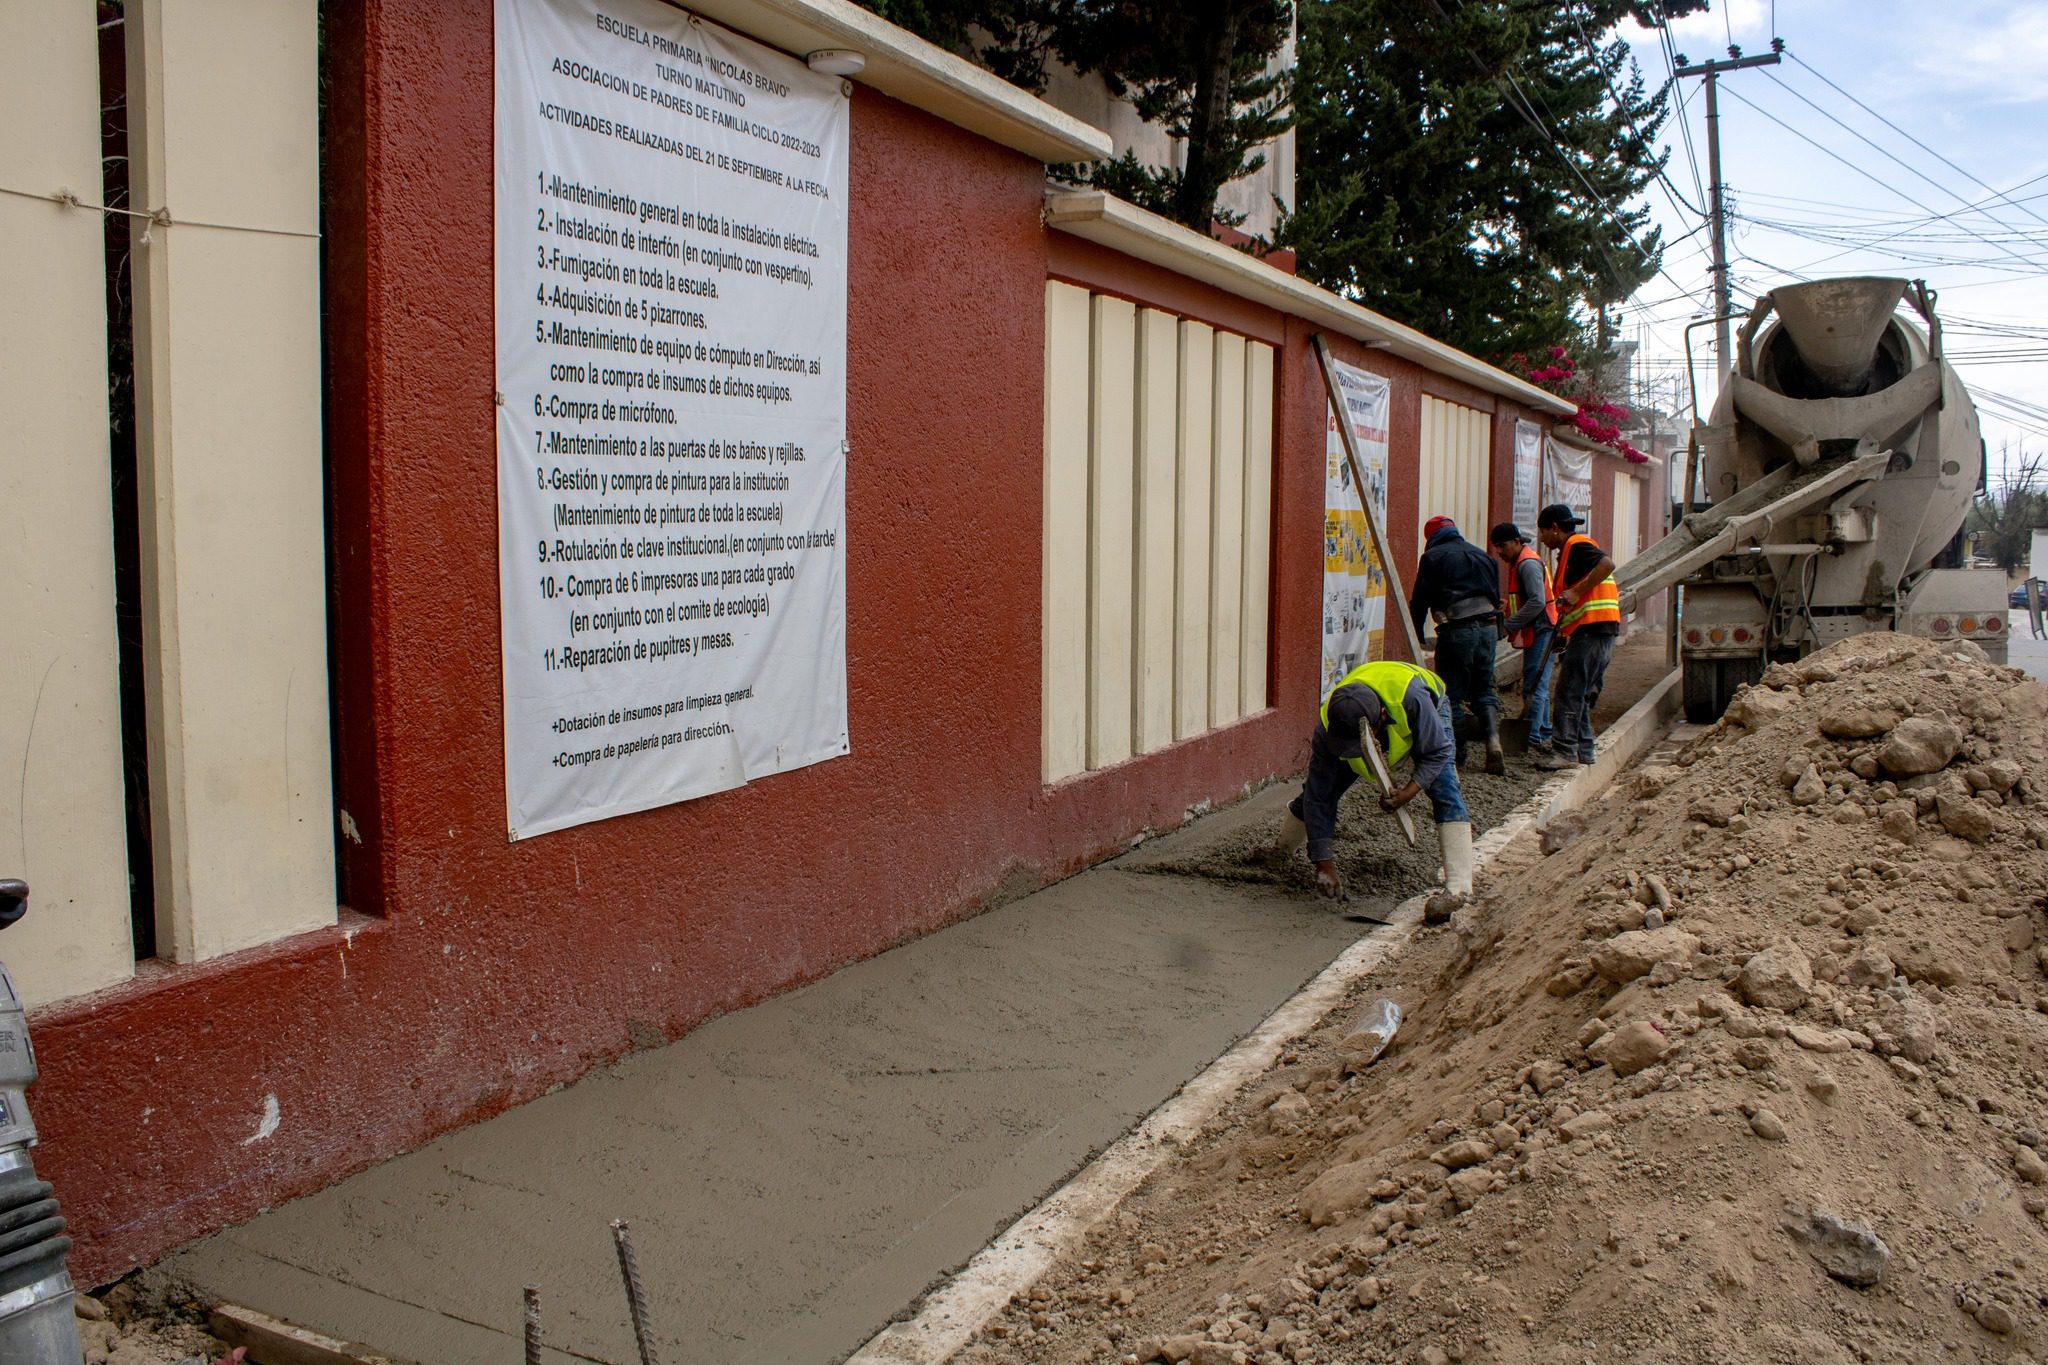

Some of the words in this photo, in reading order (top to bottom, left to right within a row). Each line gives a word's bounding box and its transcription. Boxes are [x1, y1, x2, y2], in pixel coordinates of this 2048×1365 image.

[597, 14, 650, 47] ESCUELA
[653, 35, 703, 67] PRIMARIA
[552, 57, 630, 95] ASOCIACION
[633, 84, 648, 101] DE
[651, 90, 693, 116] PADRES
[695, 104, 710, 122] DE
[712, 109, 750, 134] FAMILIA
[752, 122, 779, 144] CICLO
[781, 131, 821, 158] 2022-2023
[656, 63, 693, 88] TURNO
[695, 74, 746, 108] MATUTINO
[539, 101, 612, 136] ACTIVIDADES
[686, 145, 703, 163] DEL
[706, 150, 716, 167] 21
[718, 153, 730, 170] DE
[732, 158, 783, 187] SEPTIEMBRE
[805, 180, 829, 200] FECHA
[556, 211, 618, 247] Instalación
[621, 227, 635, 250] de
[638, 230, 680, 259] interfón
[682, 240, 698, 266] (en
[701, 248, 743, 272] conjunto
[745, 258, 762, 276] con
[765, 261, 813, 290] vespertino).
[639, 202, 680, 226] general
[682, 211, 695, 228] en
[697, 211, 719, 235] toda
[721, 216, 730, 237] la
[732, 219, 781, 249] instalación
[784, 233, 820, 258] eléctrica.
[622, 266, 636, 285] en
[639, 266, 663, 290] toda
[666, 269, 675, 291] la
[678, 277, 719, 299] escuela.
[625, 297, 638, 319] de
[641, 299, 648, 320] 5
[650, 302, 707, 329] pizarrones.
[640, 333, 653, 355] de
[656, 338, 692, 364] equipo
[694, 340, 707, 361] de
[709, 343, 751, 370] cómputo
[753, 351, 764, 368] en
[766, 350, 807, 377] Dirección,
[809, 357, 821, 375] así
[550, 363, 585, 383] como
[588, 361, 598, 384] la
[602, 368, 643, 392] compra
[647, 368, 660, 390] de
[663, 369, 706, 394] insumos
[709, 374, 721, 395] de
[723, 376, 754, 398] dichos
[756, 381, 792, 405] equipos.
[601, 399, 616, 421] de
[619, 400, 677, 425] micrófono.
[640, 440, 647, 456] a
[650, 435, 665, 457] las
[668, 439, 706, 462] puertas
[708, 438, 721, 459] de
[723, 439, 737, 459] los
[739, 440, 767, 460] baños
[769, 445, 775, 465] y
[776, 442, 806, 466] rejillas.
[601, 474, 608, 496] y
[611, 473, 652, 496] compra
[655, 469, 668, 491] de
[671, 470, 707, 495] pintura
[709, 474, 731, 496] para
[733, 471, 741, 491] la
[743, 471, 789, 491] institución
[554, 503, 641, 532] (Mantenimiento
[643, 503, 657, 524] de
[660, 503, 696, 528] pintura
[698, 502, 710, 522] de
[712, 502, 734, 522] toda
[736, 502, 744, 522] la
[746, 501, 783, 526] escuela)
[620, 537, 634, 559] de
[636, 536, 664, 558] clave
[746, 532, 785, 557] conjunto
[786, 535, 805, 550] con
[567, 574, 612, 600] Compra
[615, 571, 629, 594] de
[631, 571, 638, 592] 6
[641, 570, 698, 596] impresoras
[701, 569, 719, 587] una
[721, 568, 742, 590] para
[743, 563, 765, 583] cada
[767, 561, 795, 586] grado
[570, 610, 589, 638] (en
[592, 606, 642, 634] conjunto
[644, 606, 664, 625] con
[666, 602, 676, 622] el
[678, 600, 711, 621] comite
[713, 597, 725, 617] de
[727, 593, 770, 618] ecología)
[633, 638, 647, 660] de
[650, 634, 691, 663] pupitres
[692, 638, 699, 657] y
[701, 632, 735, 651] mesas.
[552, 712, 605, 735] +Dotación
[608, 709, 621, 725] de
[623, 703, 662, 722] insumos
[665, 699, 684, 717] para
[685, 692, 722, 710] limpieza
[724, 685, 755, 706] general.
[552, 747, 601, 769] +Compra
[603, 743, 615, 758] de
[617, 734, 659, 759] papelería
[661, 731, 682, 750] para
[684, 721, 735, 743] dirección.
